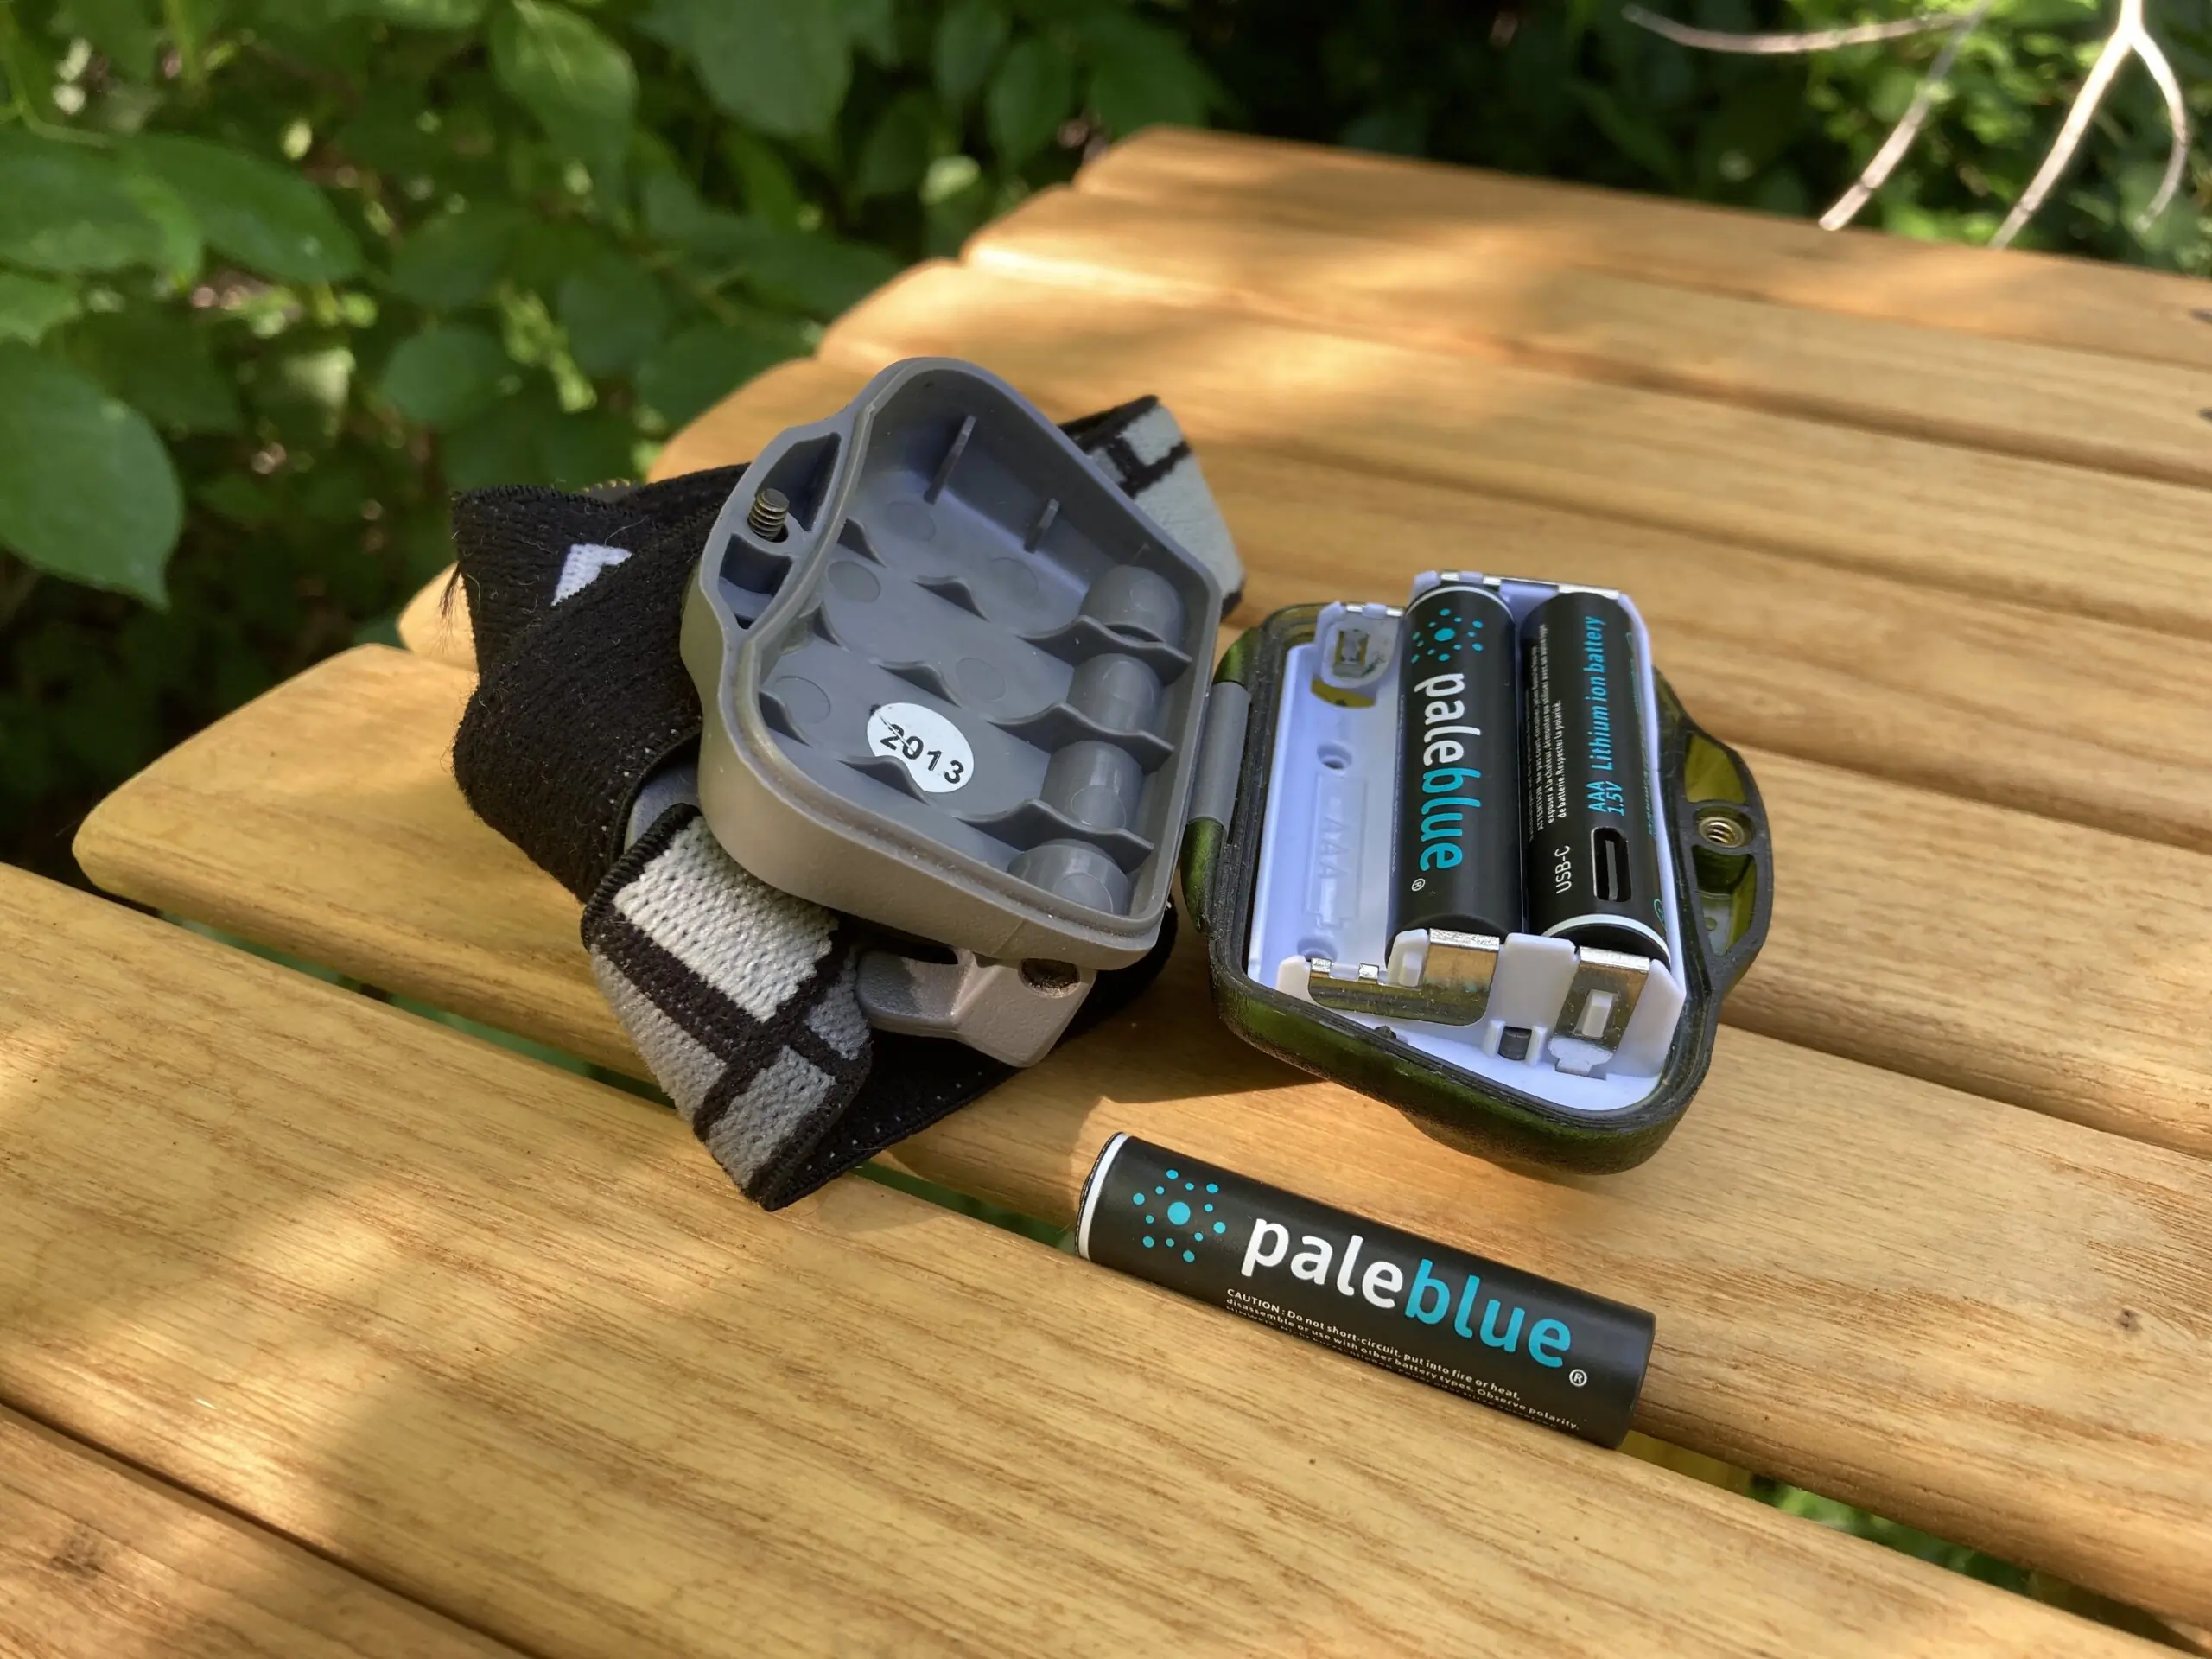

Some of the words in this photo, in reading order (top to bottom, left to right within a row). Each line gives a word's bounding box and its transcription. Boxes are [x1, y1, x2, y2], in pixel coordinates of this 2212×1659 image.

[1583, 615, 1607, 673] battery
[1585, 676, 1608, 702] ion
[880, 723, 964, 784] 2013
[1587, 705, 1613, 771] Lithium
[1414, 673, 1481, 871] paleblue
[1586, 780, 1606, 812] AAA
[1605, 780, 1624, 816] 1.5V
[1547, 793, 1555, 823] exposer
[1557, 808, 1567, 818] de
[1554, 845, 1572, 894] USB-C
[1241, 1218, 1572, 1368] paleblue
[1226, 1299, 1294, 1327] disassemble
[1312, 1330, 1331, 1340] use
[1333, 1338, 1358, 1351] with
[1361, 1348, 1392, 1363] other
[1395, 1358, 1437, 1380] battery
[1478, 1389, 1526, 1411] Observe
[1287, 1310, 1303, 1321] Do
[1306, 1319, 1325, 1330] not
[1327, 1325, 1402, 1357] short-circuit,
[1403, 1353, 1424, 1367] put
[1426, 1360, 1450, 1375] into
[1452, 1370, 1472, 1382] fire
[1475, 1378, 1489, 1389] or
[1491, 1383, 1520, 1401] heat,
